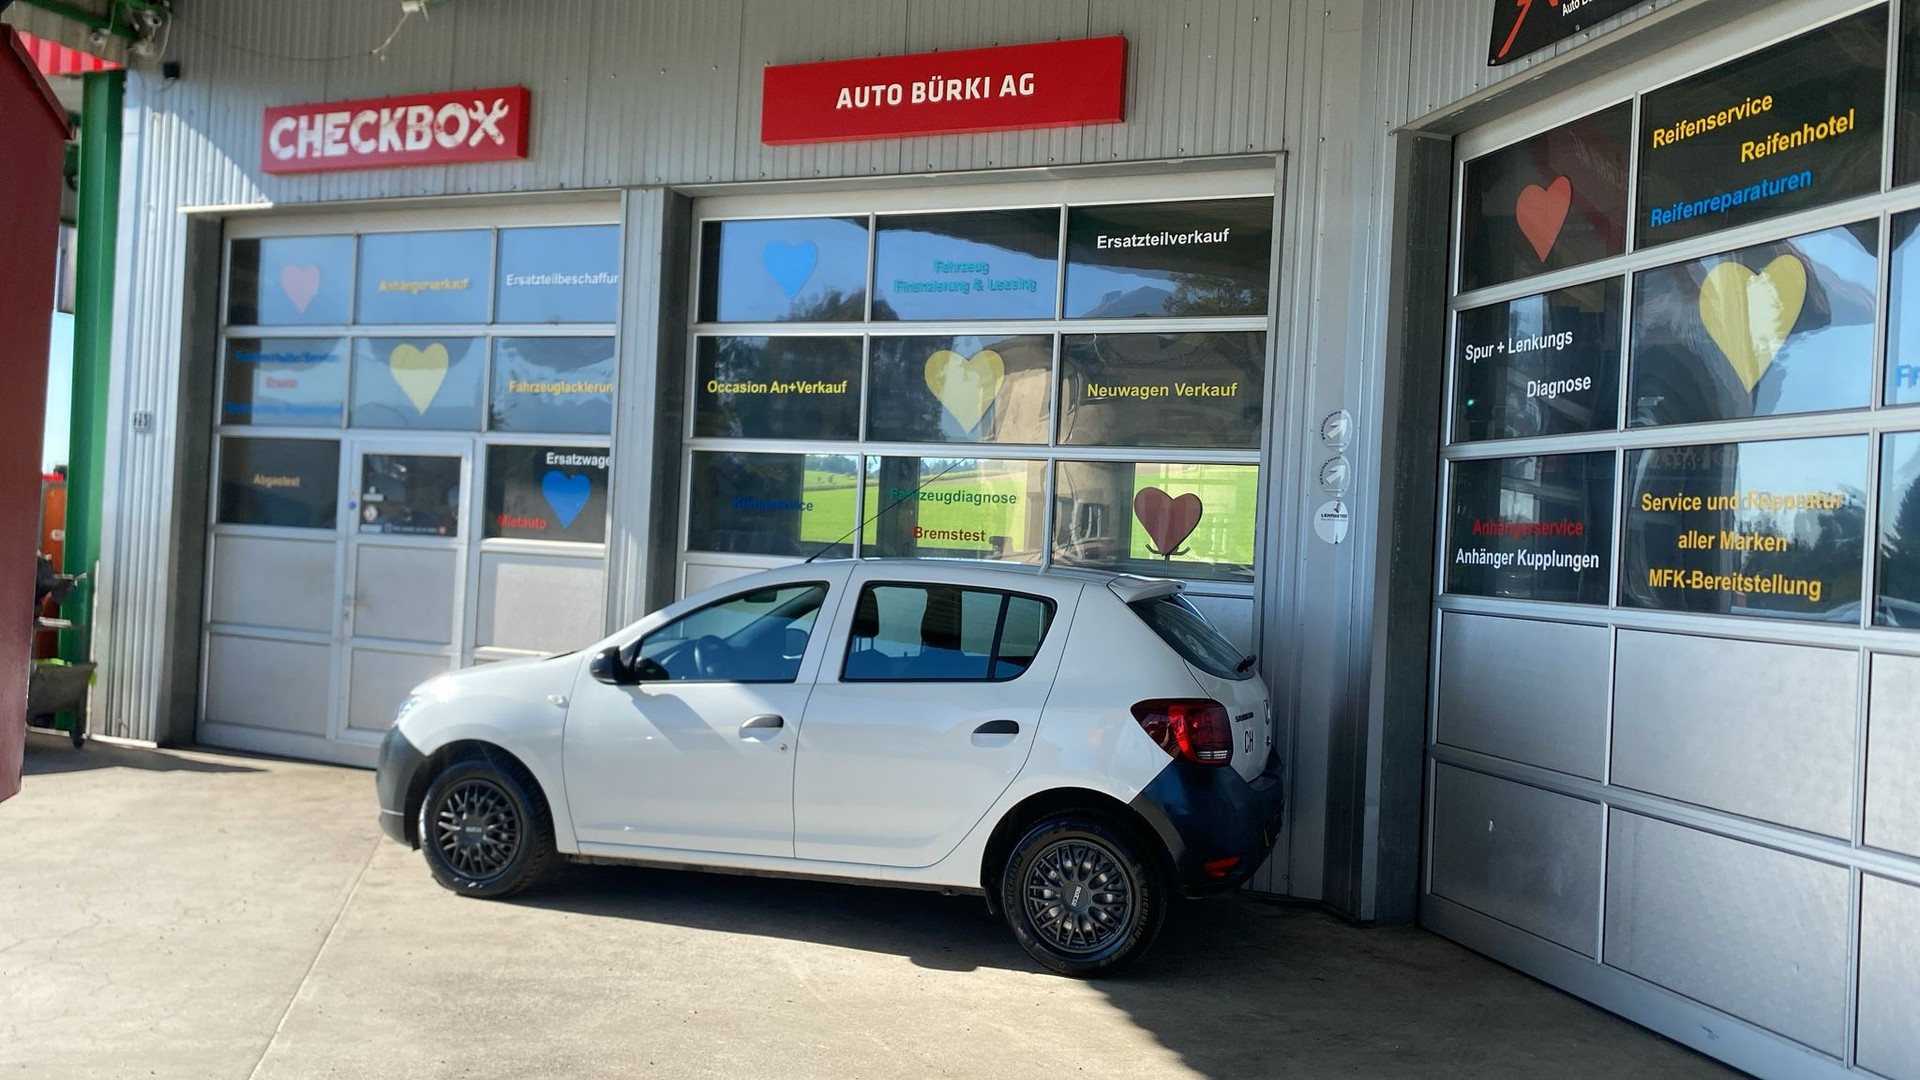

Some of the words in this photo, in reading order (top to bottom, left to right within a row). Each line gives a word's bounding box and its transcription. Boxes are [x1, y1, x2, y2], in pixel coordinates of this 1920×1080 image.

[1562, 0, 1580, 17] Auto
[835, 84, 903, 110] AUTO
[910, 75, 990, 104] BÜRKI
[999, 72, 1035, 98] AG
[269, 98, 510, 161] CHECKBOX
[1651, 93, 1774, 149] Reifenservice
[1740, 108, 1856, 163] Reifenhotel
[1650, 169, 1813, 228] Reifenreparaturen
[1096, 227, 1230, 250] Ersatzteilverkauf
[1465, 344, 1494, 364] Spur
[1497, 341, 1505, 354] +
[1508, 330, 1574, 355] Lenkungs
[706, 380, 767, 394] Occasion
[770, 380, 848, 395] An+Verkauf
[1087, 383, 1170, 400] Neuwagen
[1174, 381, 1239, 397] Verkauf
[1526, 375, 1592, 400] Diagnose
[1641, 492, 1702, 512] Service
[1707, 490, 1740, 511] und
[498, 513, 547, 530] Mietauto
[1472, 519, 1584, 540] Anhängerservice
[912, 526, 986, 543] Bremstest
[1678, 531, 1716, 550] aller
[1720, 531, 1788, 552] Marken
[1455, 547, 1514, 570] Anhänger
[1517, 548, 1600, 573] Kupplungen
[1649, 569, 1823, 603] MFK-Bereitstellung
[1244, 730, 1254, 754] CH
